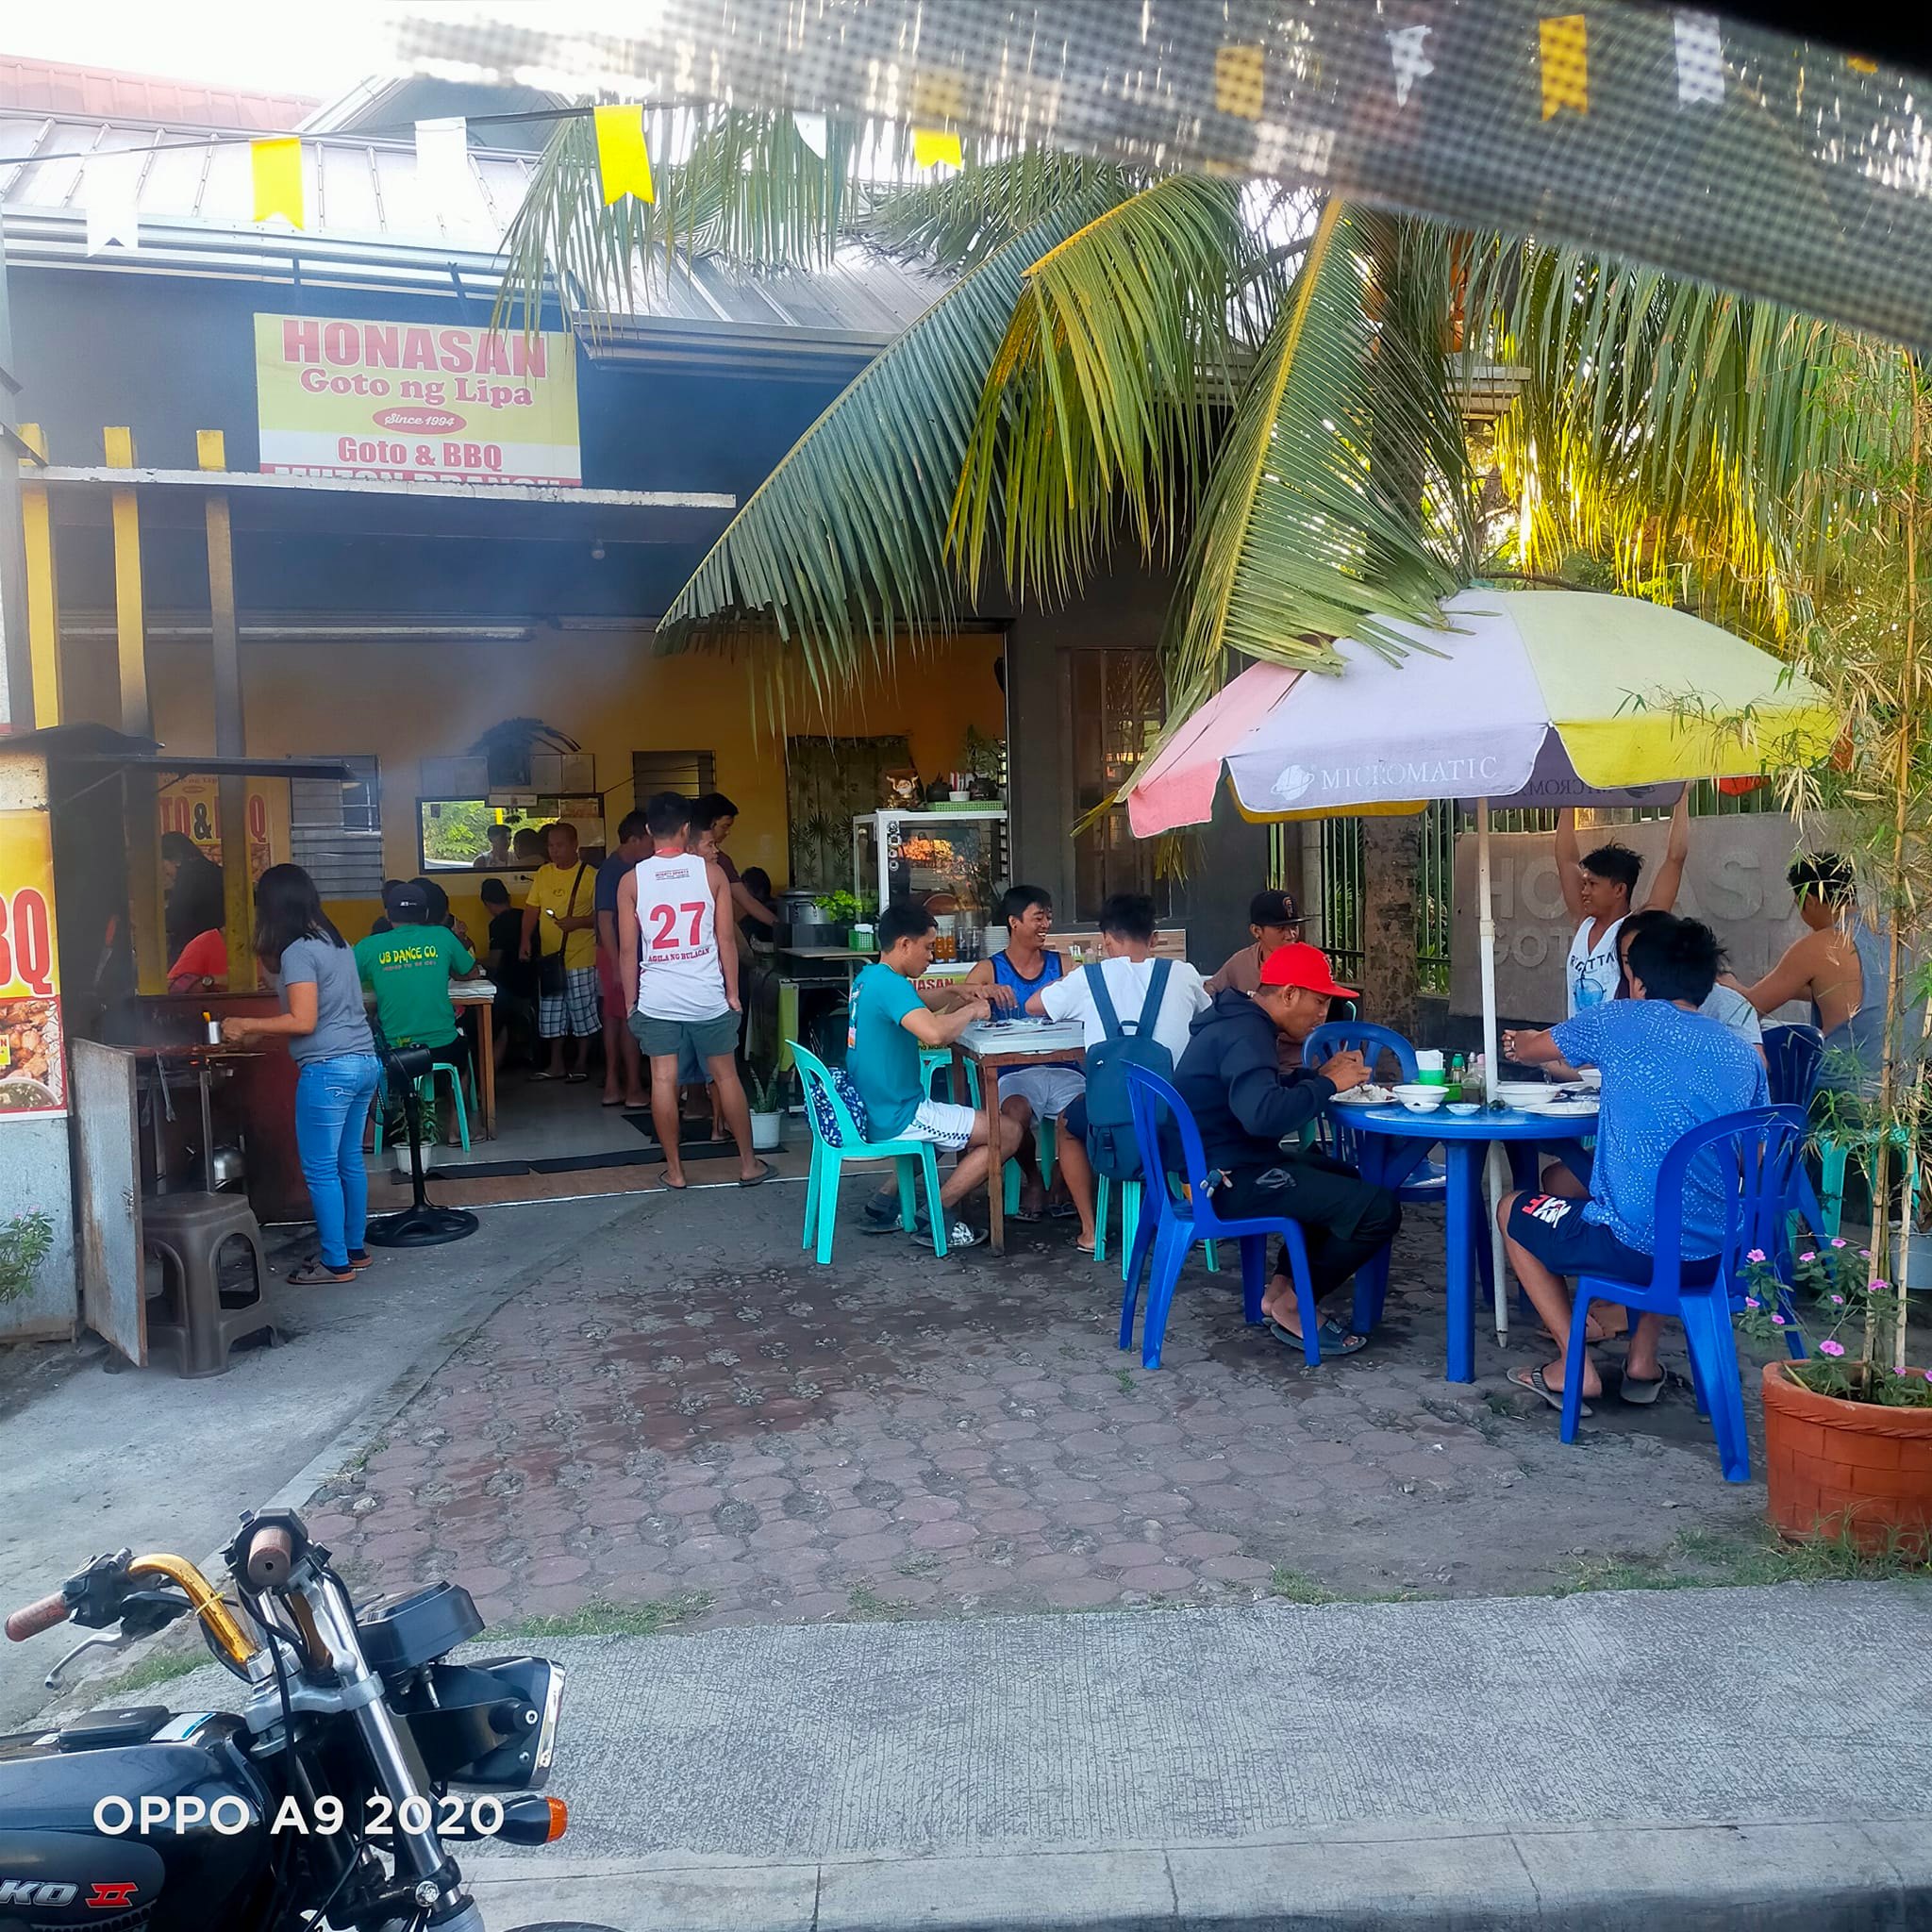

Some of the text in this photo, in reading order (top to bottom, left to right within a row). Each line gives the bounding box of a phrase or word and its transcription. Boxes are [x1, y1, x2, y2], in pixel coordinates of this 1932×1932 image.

[283, 319, 546, 378] HONASAN
[301, 368, 533, 408] Goto ng Lipa
[384, 413, 455, 426] Since 1994
[338, 436, 503, 472] Goto & BBQ
[1321, 757, 1498, 790] MICROMATIC
[649, 901, 706, 950] 27
[379, 946, 439, 964] UB DANCE CO.
[680, 948, 710, 959] BULACAN
